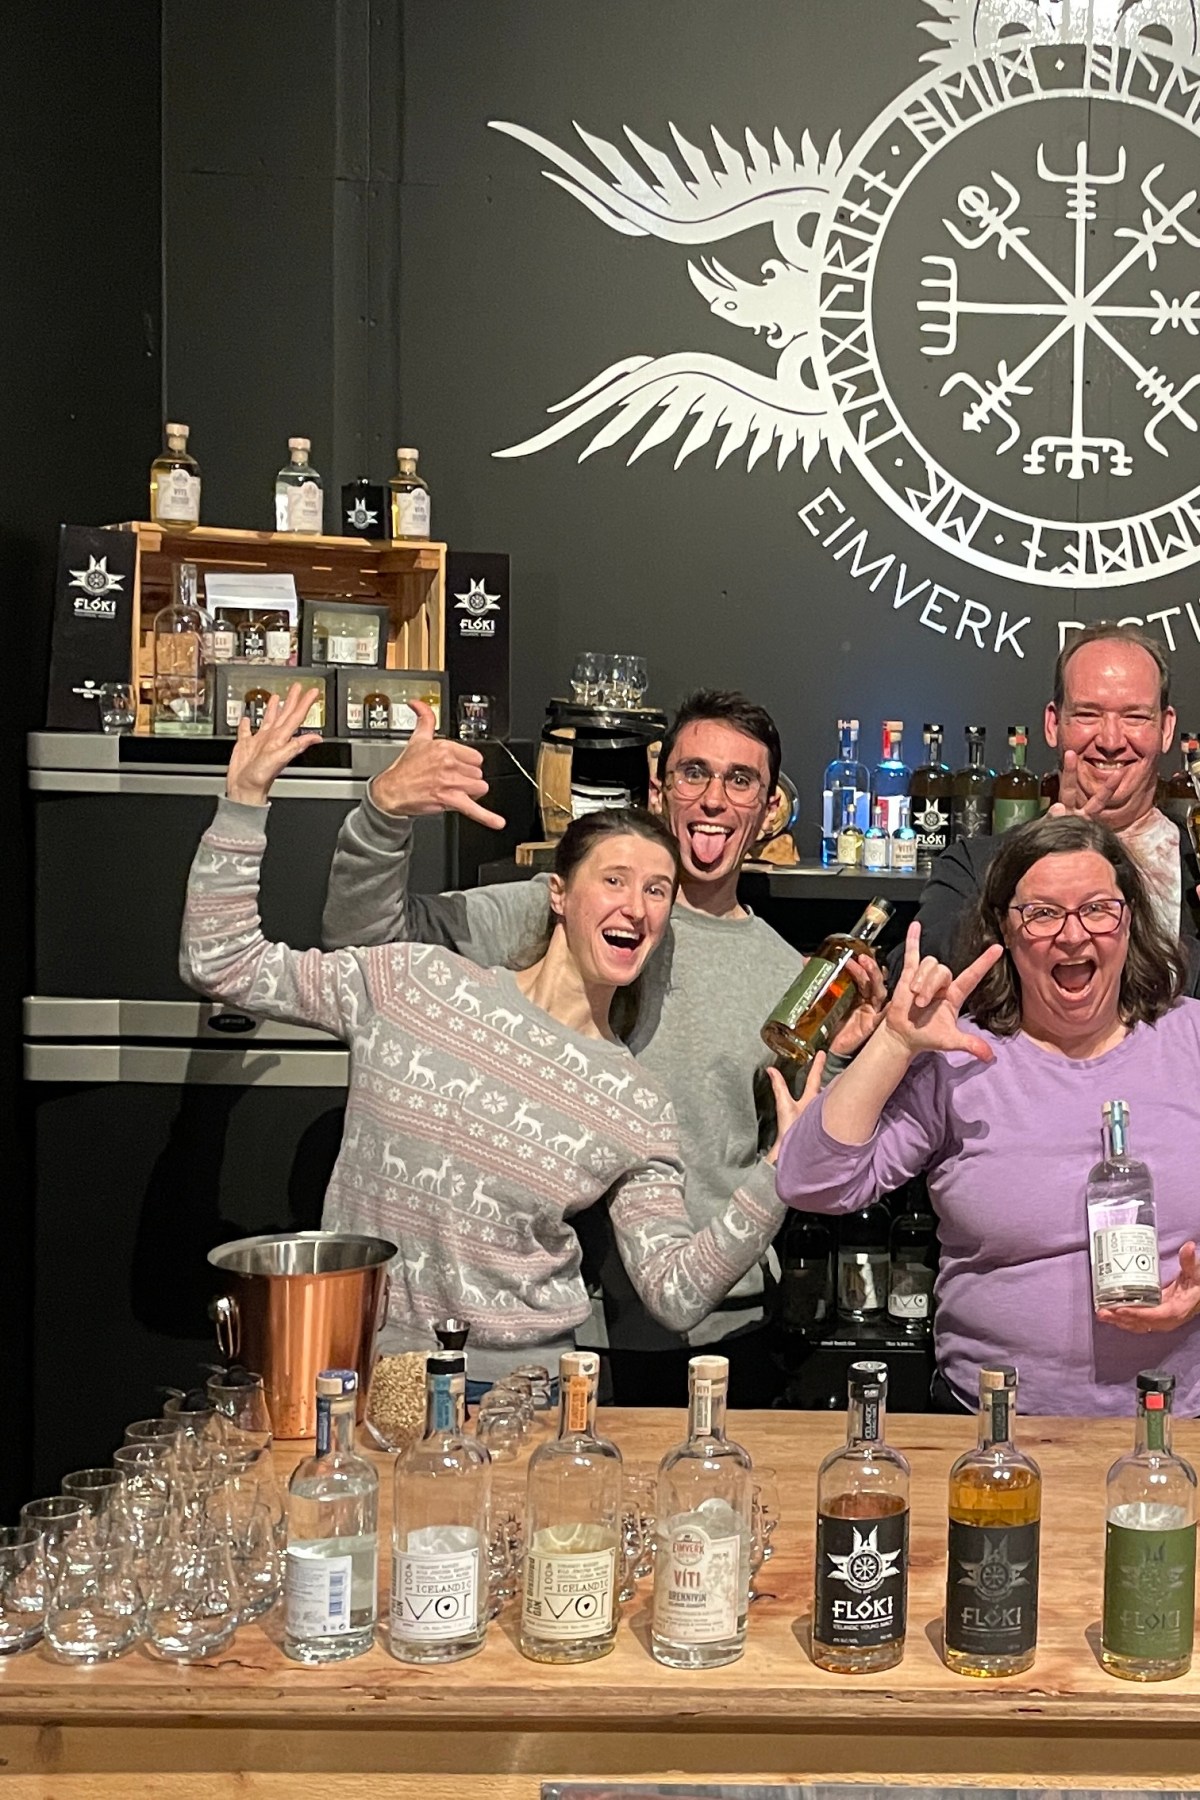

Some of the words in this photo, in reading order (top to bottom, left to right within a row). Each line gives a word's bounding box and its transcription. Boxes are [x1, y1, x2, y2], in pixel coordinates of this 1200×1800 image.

[797, 486, 1032, 659] EIMVERK
[73, 597, 116, 613] FLÓKI
[459, 617, 495, 631] FLÓKI
[915, 833, 946, 845] FLÓKI
[673, 1567, 701, 1588] VÍTI
[415, 1580, 472, 1594] ICELANDIC
[556, 1579, 609, 1593] ICELANDIC
[831, 1595, 894, 1619] FLÓKI
[960, 1604, 1021, 1627] FLÓKI
